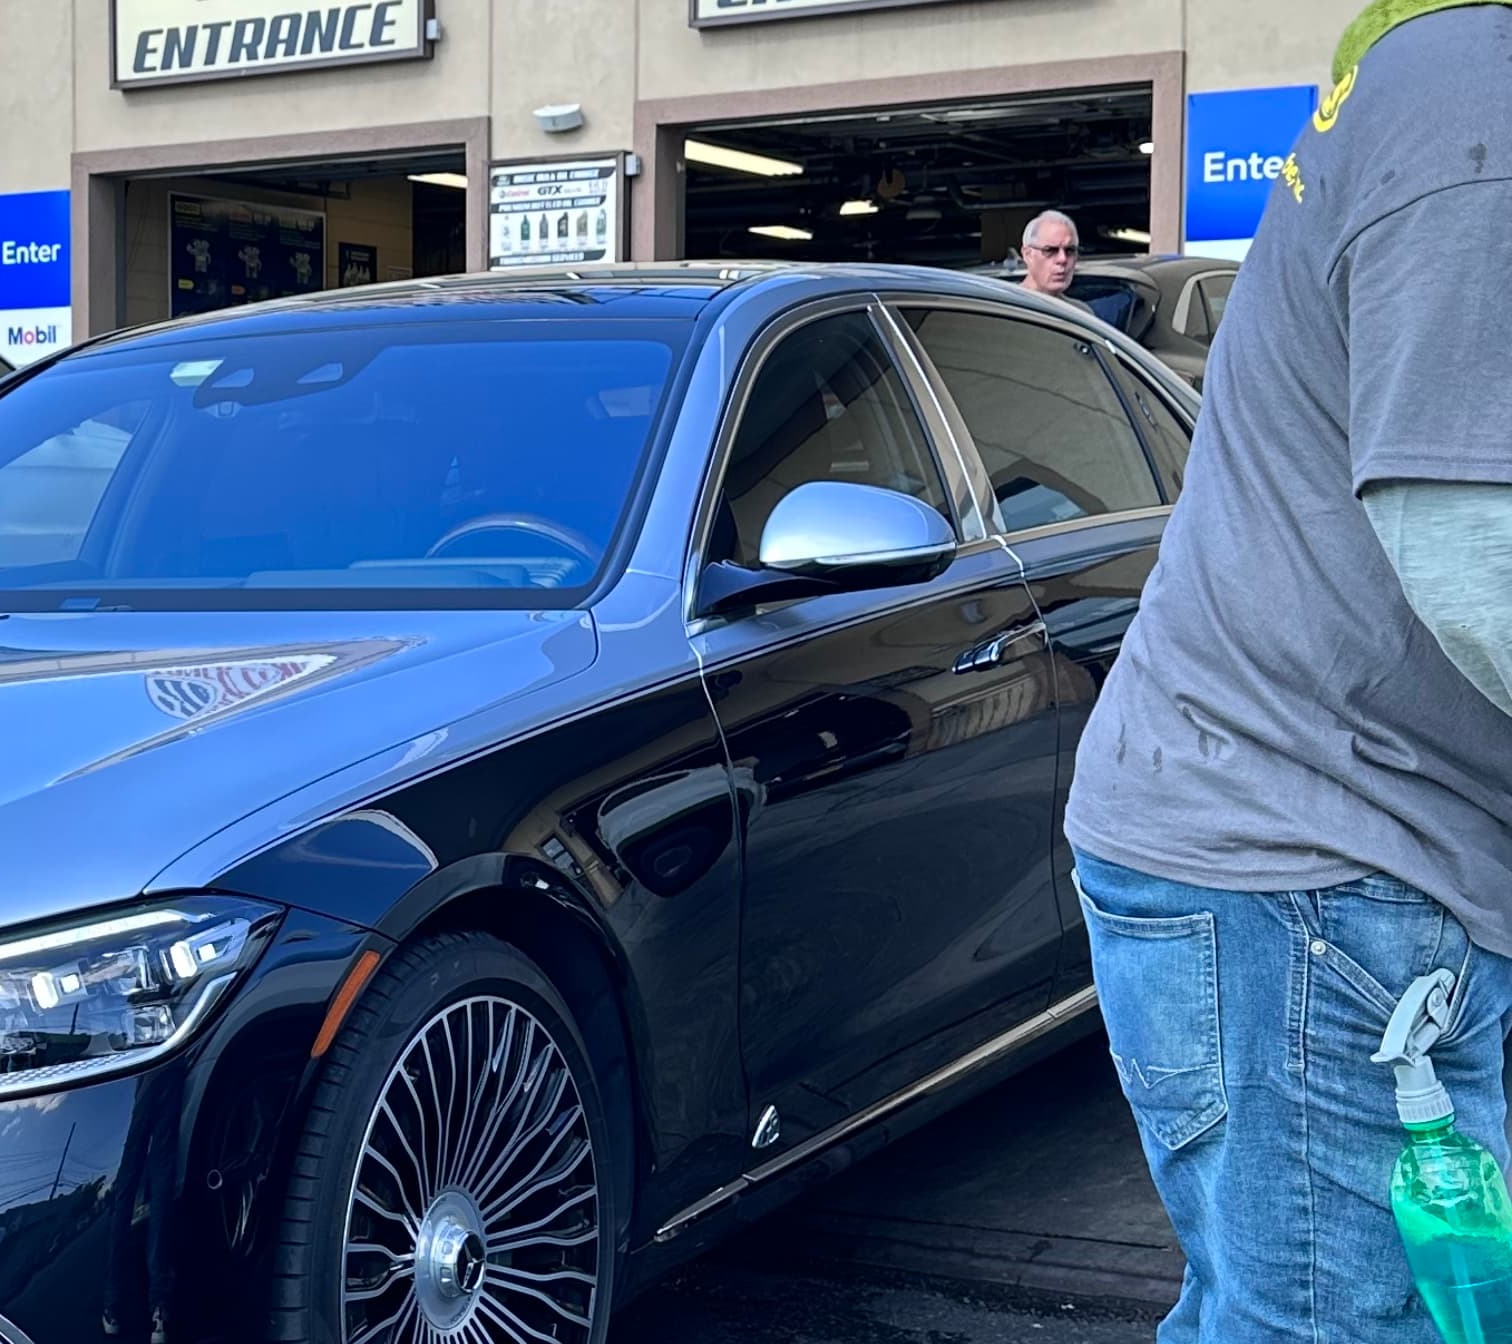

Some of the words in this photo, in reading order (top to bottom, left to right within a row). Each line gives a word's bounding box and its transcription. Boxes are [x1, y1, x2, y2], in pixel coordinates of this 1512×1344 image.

[133, 0, 403, 74] ENTRANCE
[1203, 151, 1285, 182] Ente
[1, 240, 62, 265] Enter
[8, 324, 57, 346] Mobil
